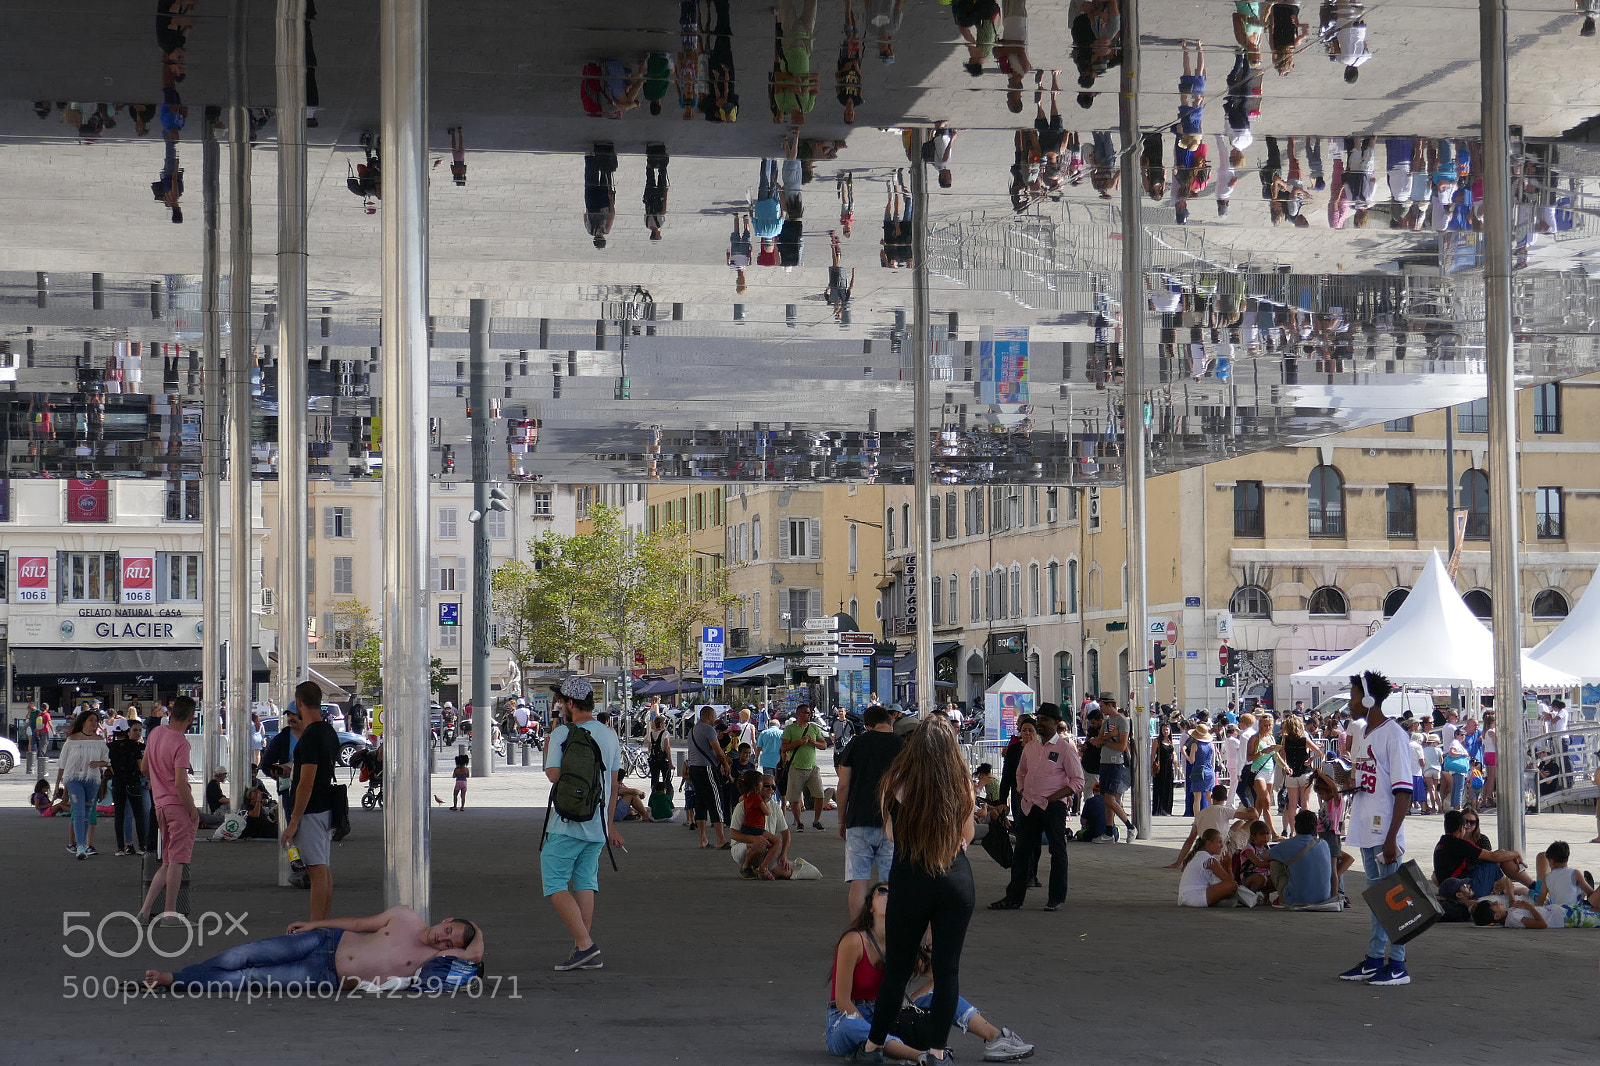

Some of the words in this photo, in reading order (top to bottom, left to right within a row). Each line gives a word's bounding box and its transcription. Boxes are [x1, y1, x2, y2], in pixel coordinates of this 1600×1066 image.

[905, 556, 916, 564] LE
[21, 565, 47, 578] RTL2
[126, 566, 151, 579] RTL2
[125, 592, 151, 601] 106.8
[78, 608, 112, 618] GELATO
[114, 608, 154, 618] NATURAL
[159, 608, 183, 618] CASA
[95, 622, 174, 638] GLACIER
[707, 628, 719, 642] P
[1361, 773, 1377, 795] 29
